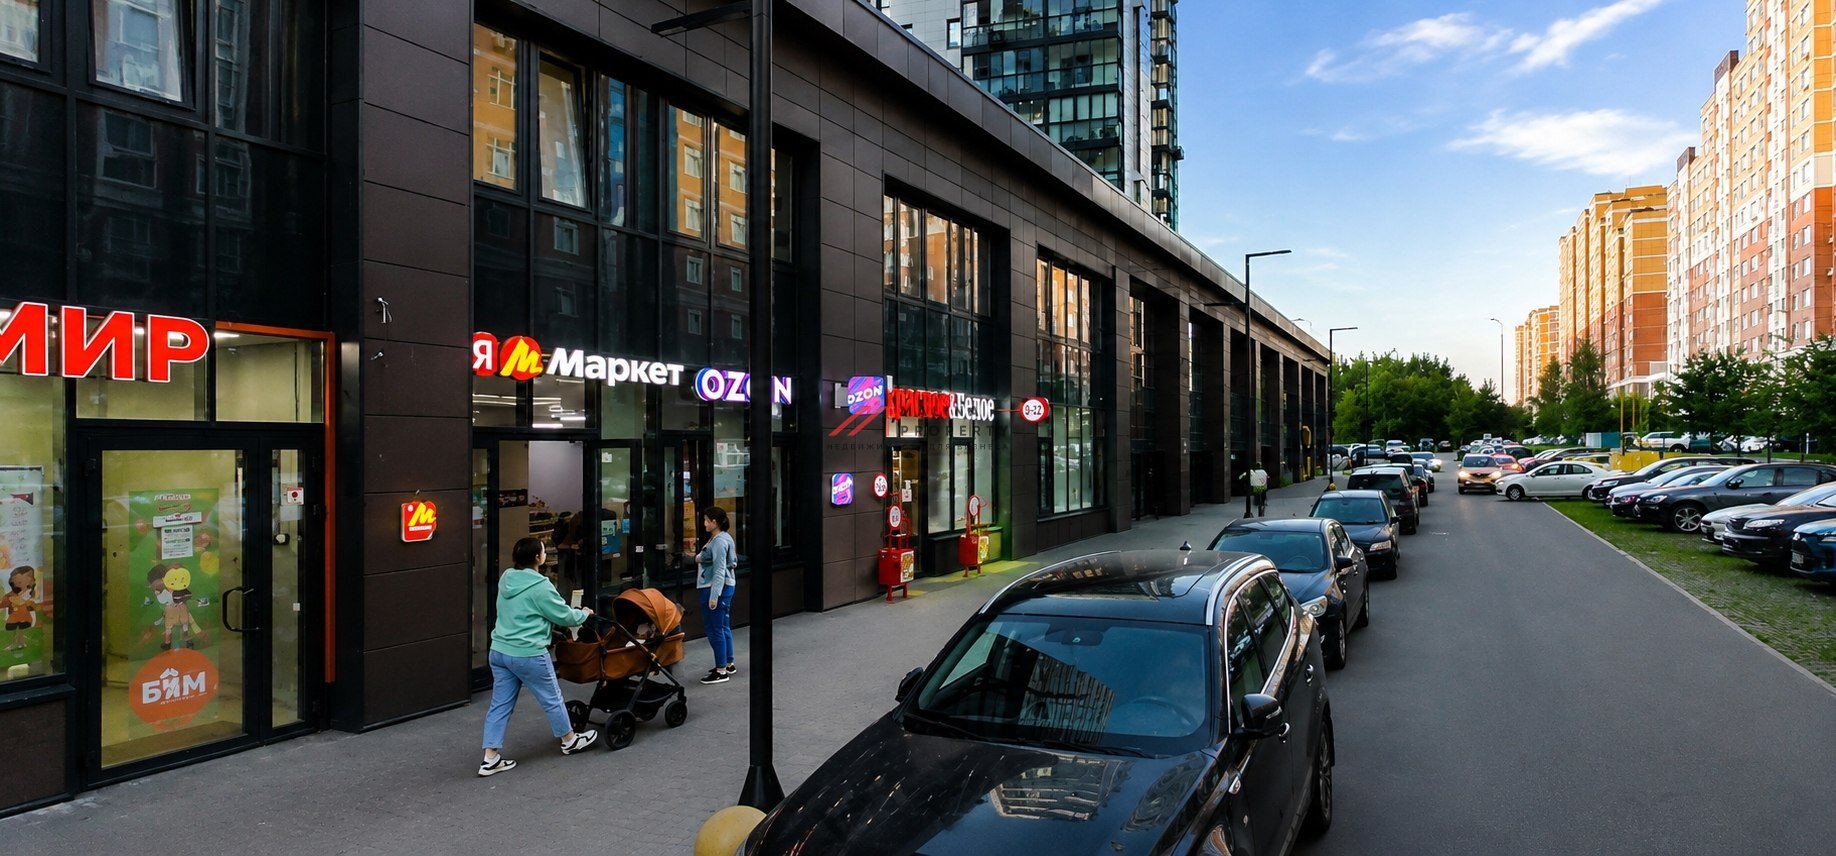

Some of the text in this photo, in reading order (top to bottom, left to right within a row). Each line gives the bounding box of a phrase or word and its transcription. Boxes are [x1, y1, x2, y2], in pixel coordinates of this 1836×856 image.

[473, 339, 492, 370] Я
[546, 347, 684, 387] Маркет
[697, 368, 792, 405] OZN
